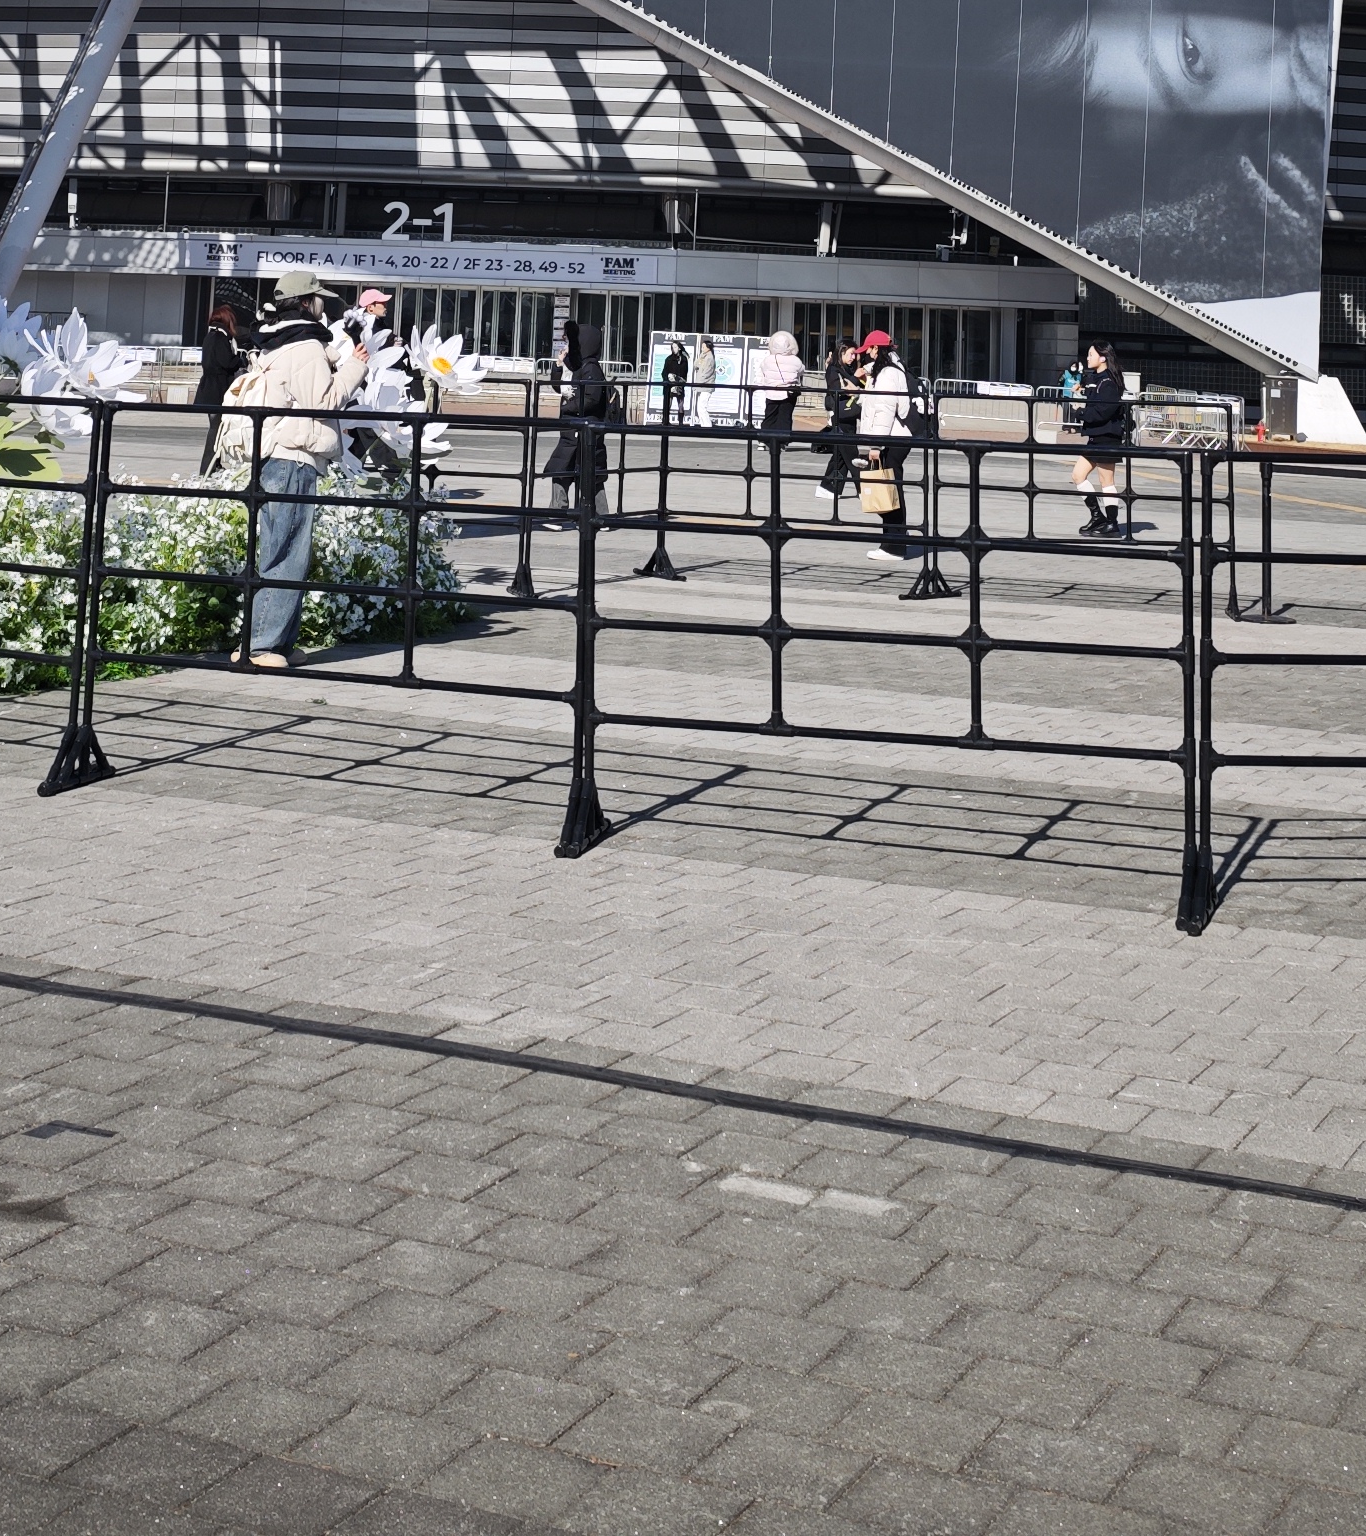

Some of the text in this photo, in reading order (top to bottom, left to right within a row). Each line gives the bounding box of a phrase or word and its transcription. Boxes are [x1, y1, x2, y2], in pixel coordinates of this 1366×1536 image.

[381, 200, 454, 243] 2-1
[256, 250, 305, 265] FLOOR
[353, 254, 367, 266] 1F
[463, 257, 482, 270] 2F
